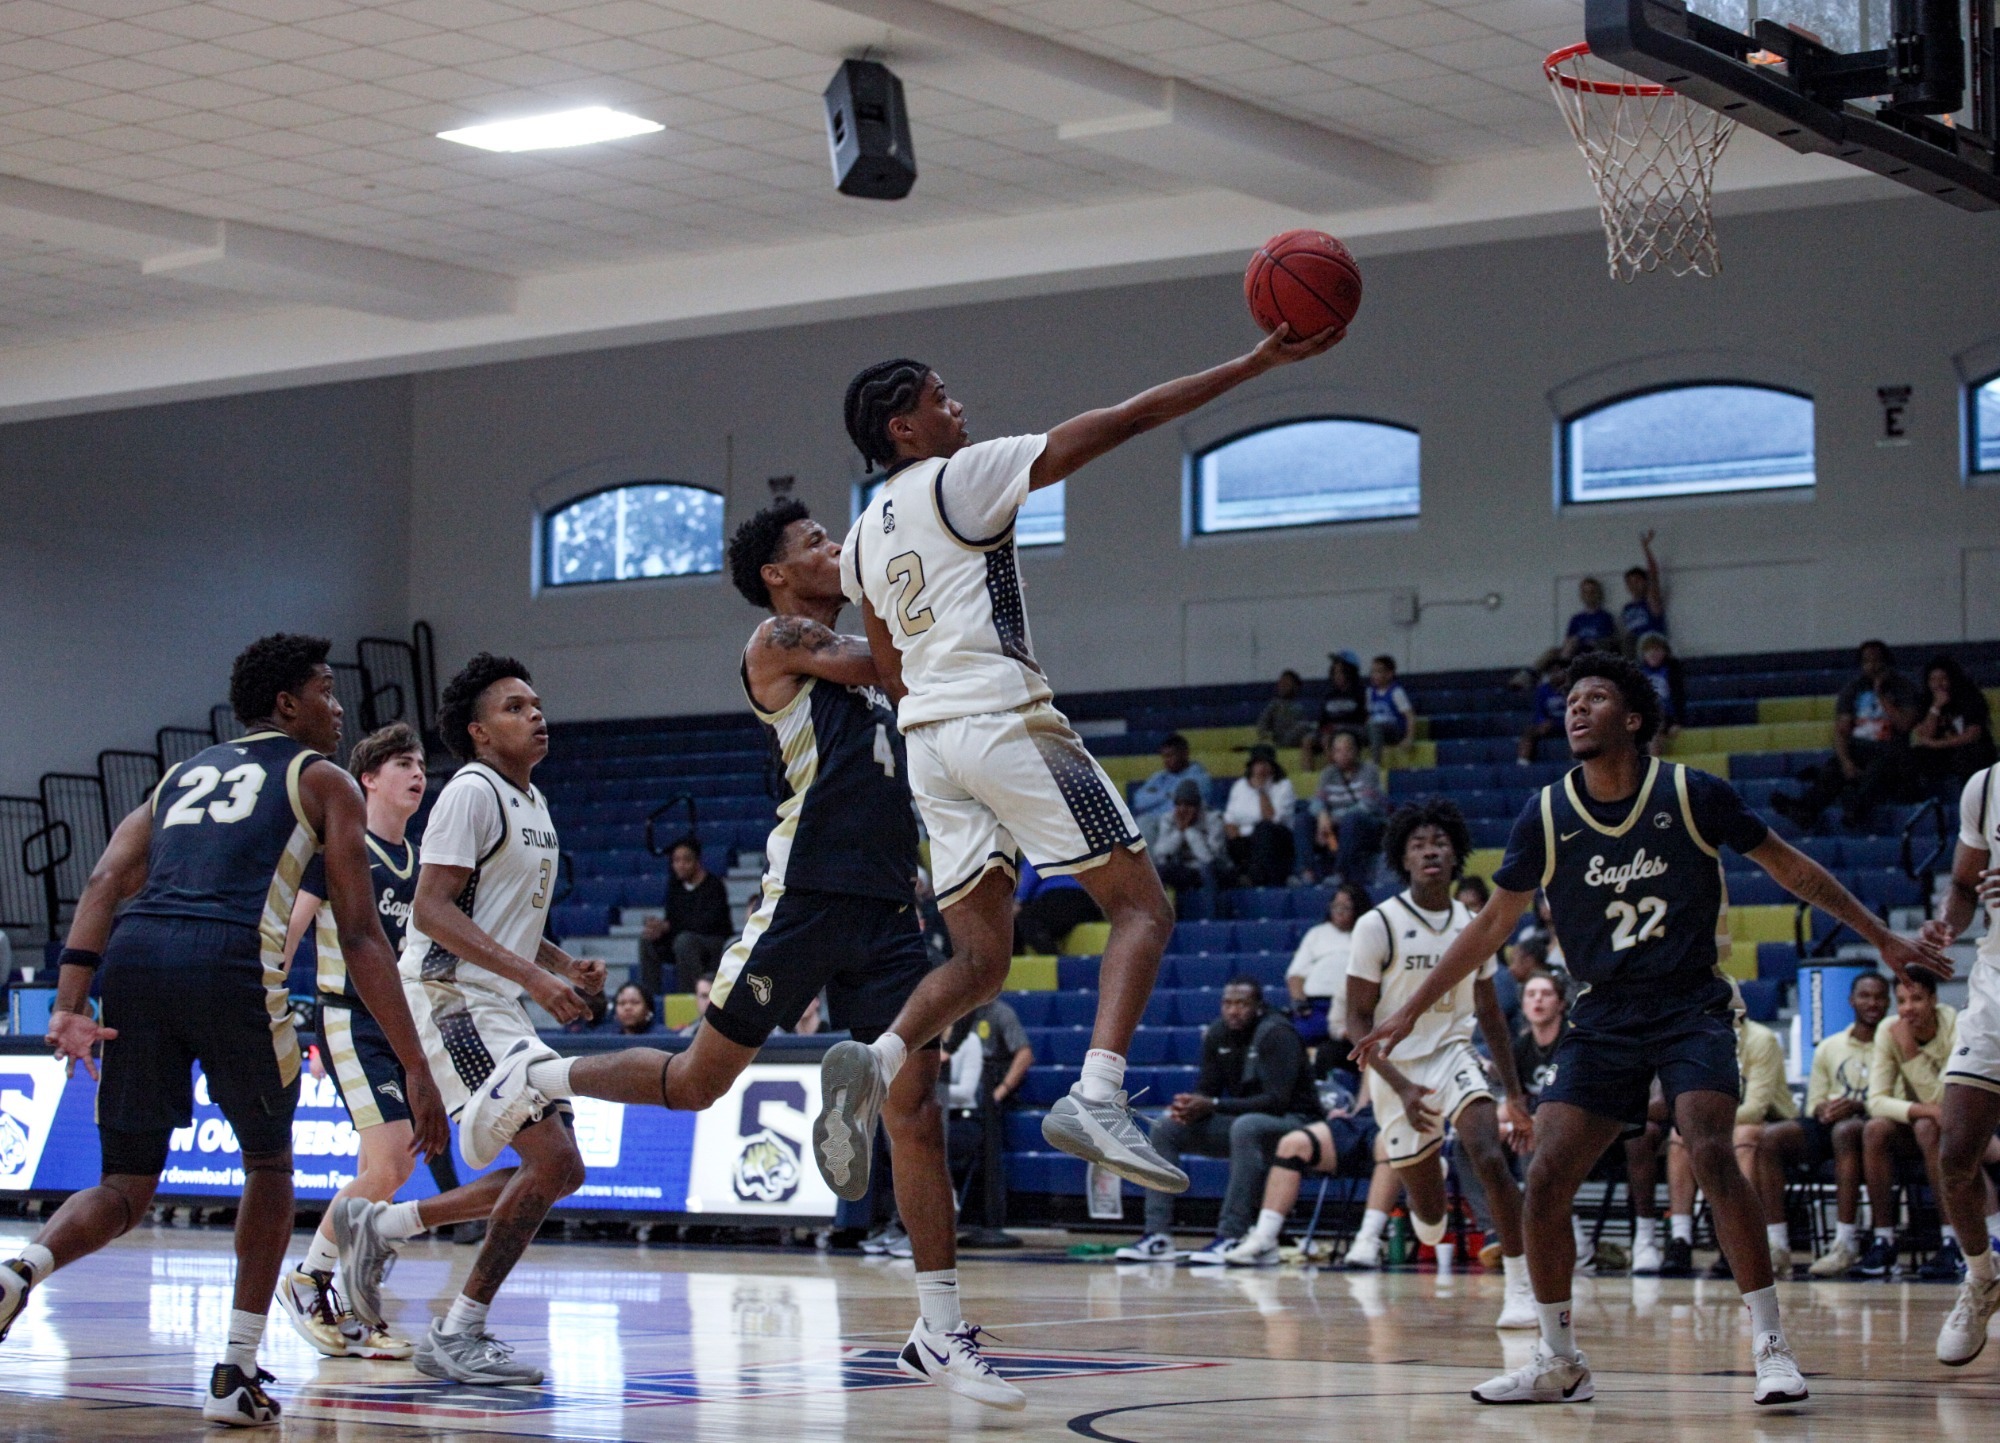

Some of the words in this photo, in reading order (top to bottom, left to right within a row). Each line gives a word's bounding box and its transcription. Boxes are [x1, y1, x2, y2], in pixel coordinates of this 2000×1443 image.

[886, 550, 936, 637] 2
[873, 723, 896, 778] 4
[163, 763, 267, 829] 23
[532, 858, 552, 909] 3
[1584, 848, 1669, 893] Eagles
[1605, 896, 1668, 952] 22
[167, 1166, 232, 1185] download
